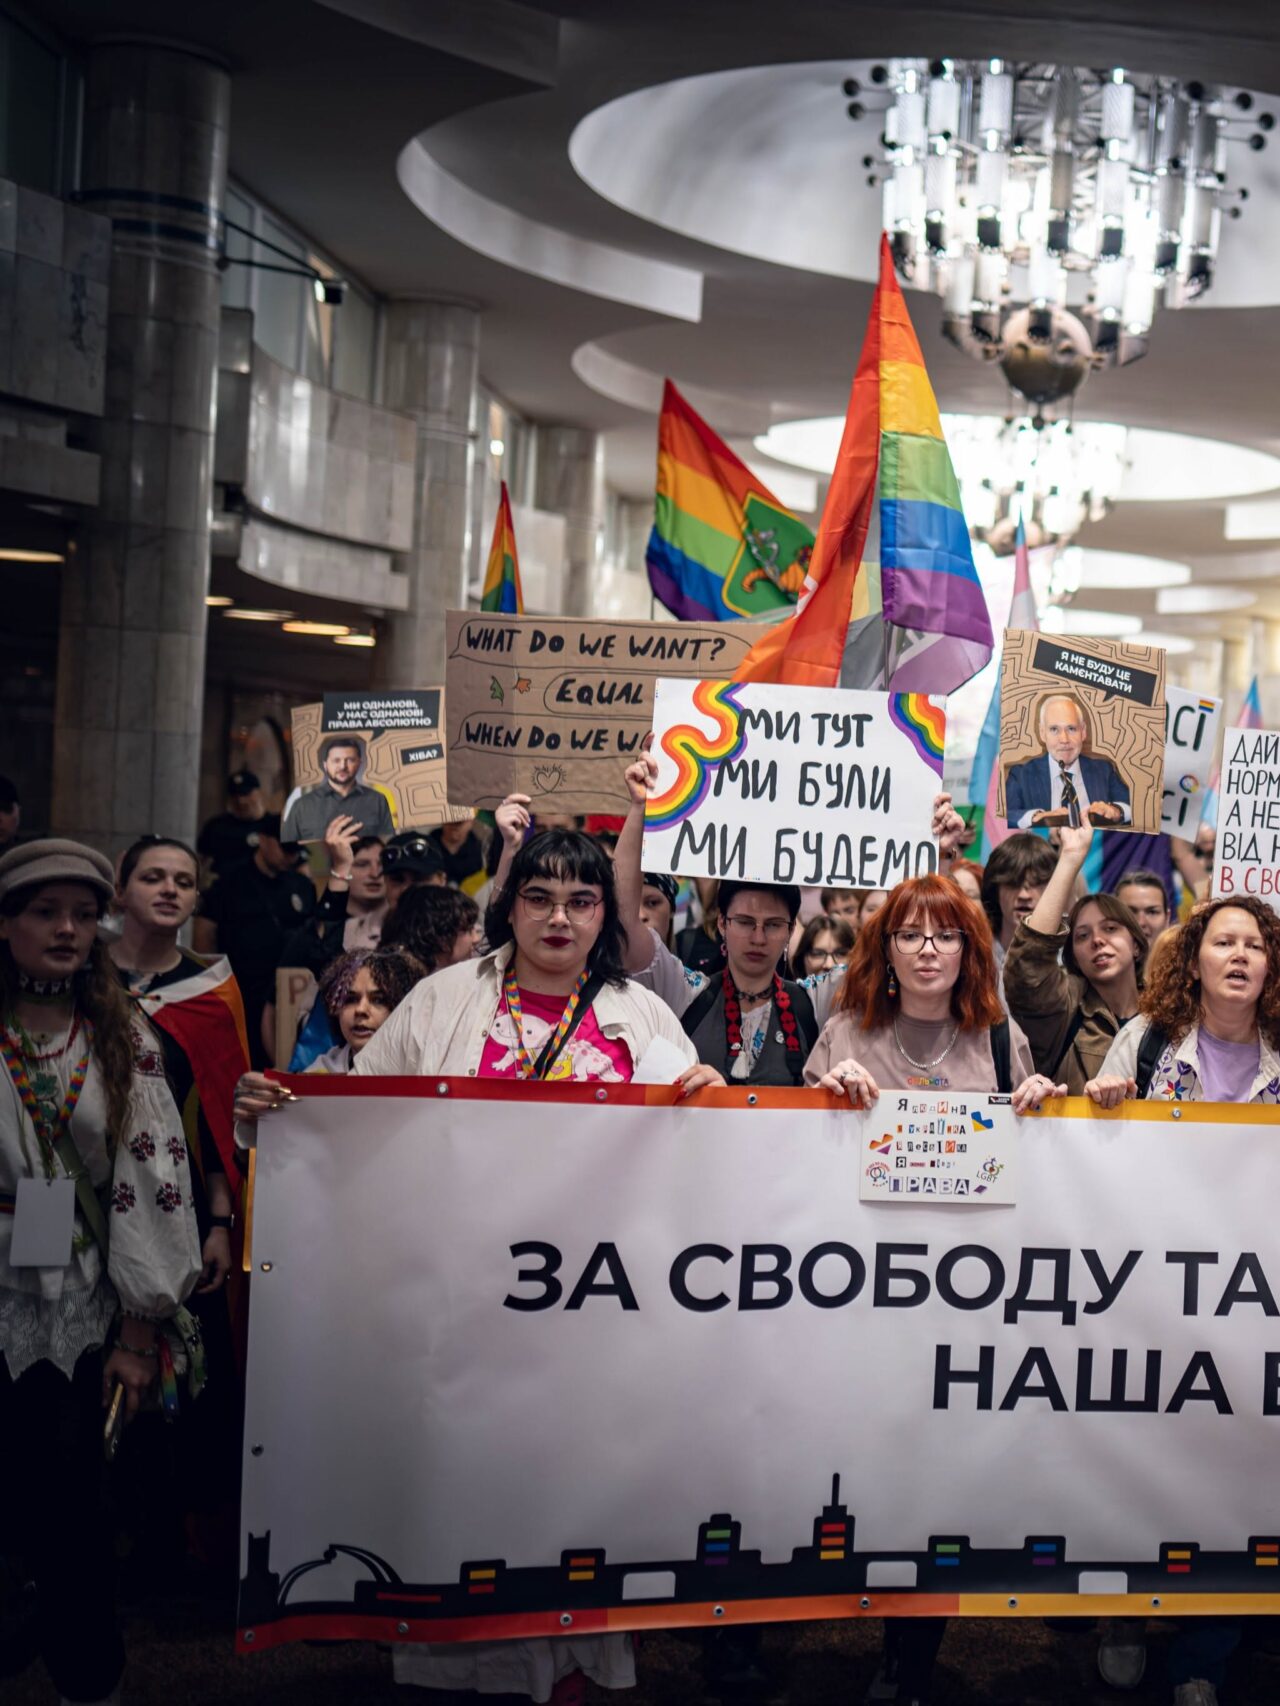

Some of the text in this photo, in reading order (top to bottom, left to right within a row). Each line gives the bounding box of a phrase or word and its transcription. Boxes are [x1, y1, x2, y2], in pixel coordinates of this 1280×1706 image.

[465, 626, 522, 652] WHAT
[578, 633, 616, 658] WE
[629, 635, 727, 662] WANT?
[1060, 651, 1131, 681] Я НЕ БУДУ ЦЕ
[337, 708, 424, 719] У НАС ОДНАКОВІ
[343, 701, 360, 710] МИ
[328, 717, 432, 729] ПРАВА АБСОЛЮТНО
[464, 721, 522, 748] WHEN
[570, 728, 609, 751] WE
[736, 708, 873, 748] МИ ТУТ
[713, 758, 892, 814] МИ БУЛИ
[1225, 798, 1242, 827] А
[1251, 800, 1280, 830] НЕ
[670, 818, 938, 888] МИ БУДЕМО
[1221, 831, 1262, 865] ВІД
[1220, 865, 1235, 893] В
[897, 1098, 909, 1111] Я
[889, 1176, 970, 1195] ПРАВА
[502, 1240, 641, 1312] ЗА
[669, 1241, 1144, 1326] СВОБОДУ
[1165, 1251, 1280, 1317] ТА
[932, 1344, 1234, 1415] НАША
